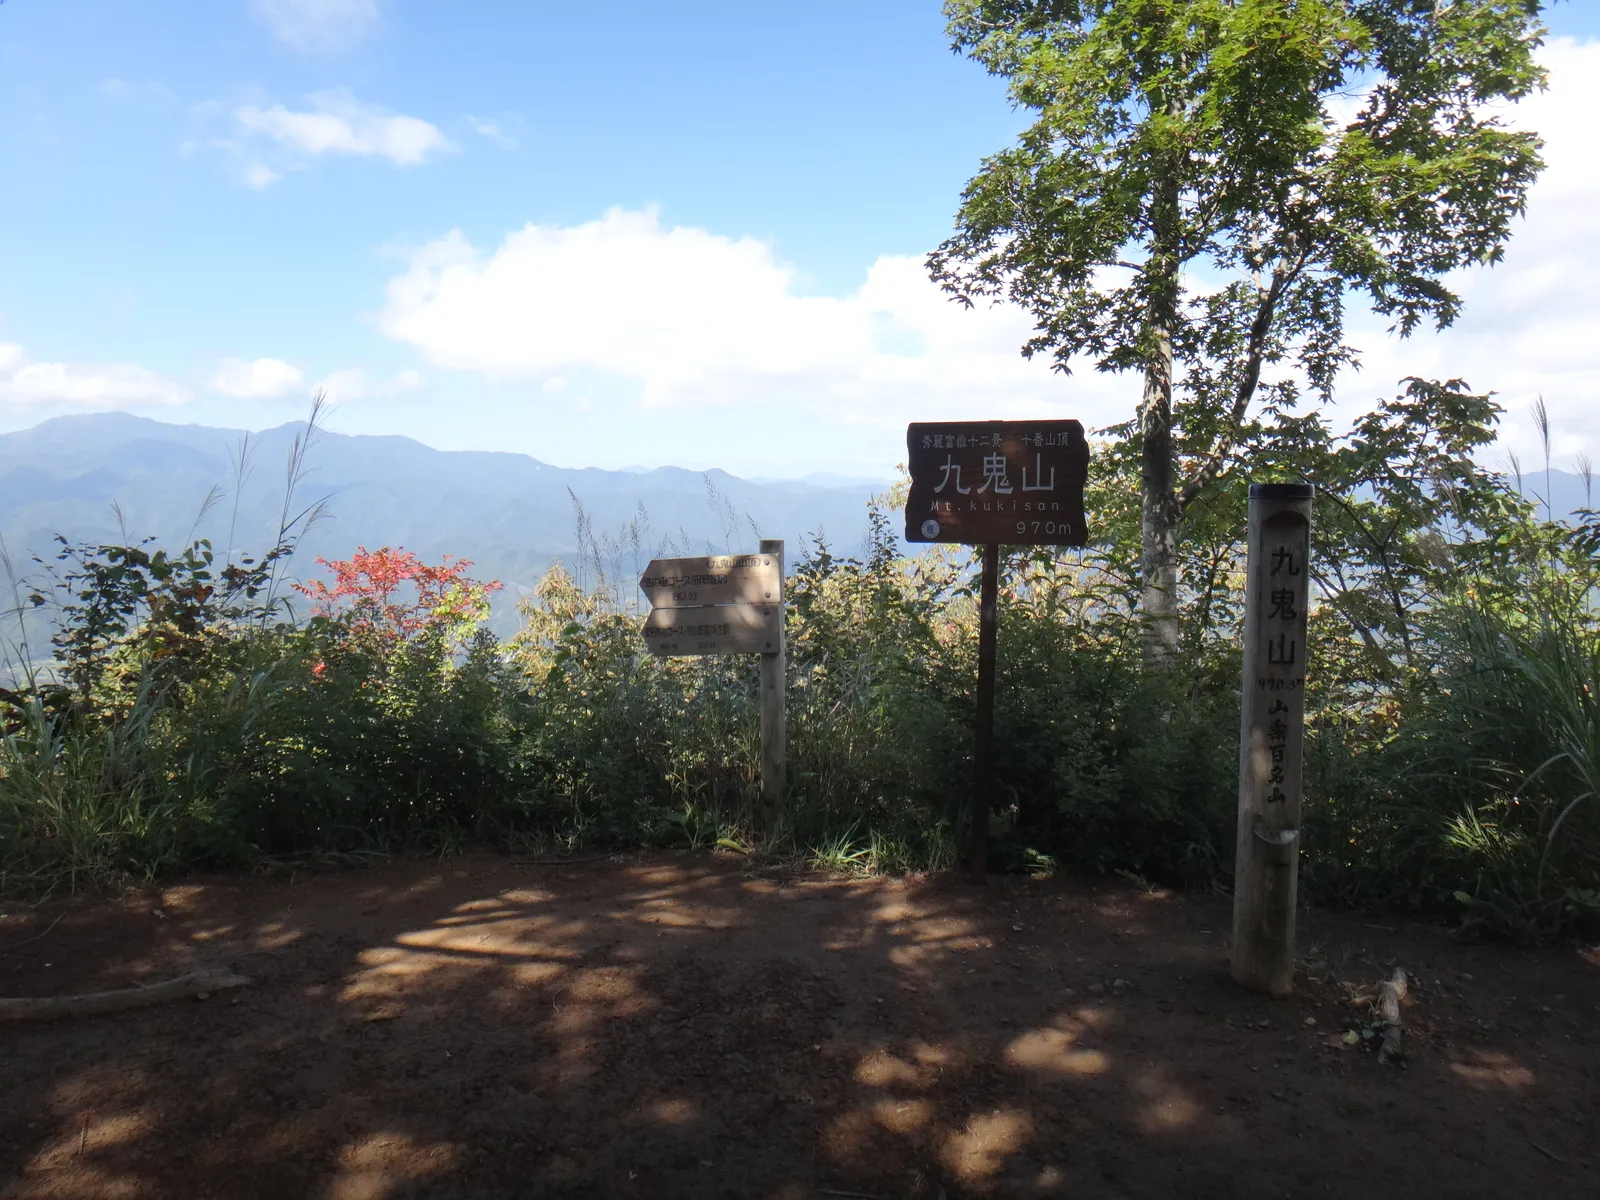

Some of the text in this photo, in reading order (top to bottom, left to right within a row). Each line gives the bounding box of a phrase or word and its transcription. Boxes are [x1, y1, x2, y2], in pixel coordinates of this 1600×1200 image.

[1020, 432, 1069, 447] 十番山頂
[933, 452, 1055, 494] 九鬼山
[930, 501, 961, 511] Mt.
[1016, 521, 1072, 535] 970m
[1267, 546, 1299, 665] 九鬼山
